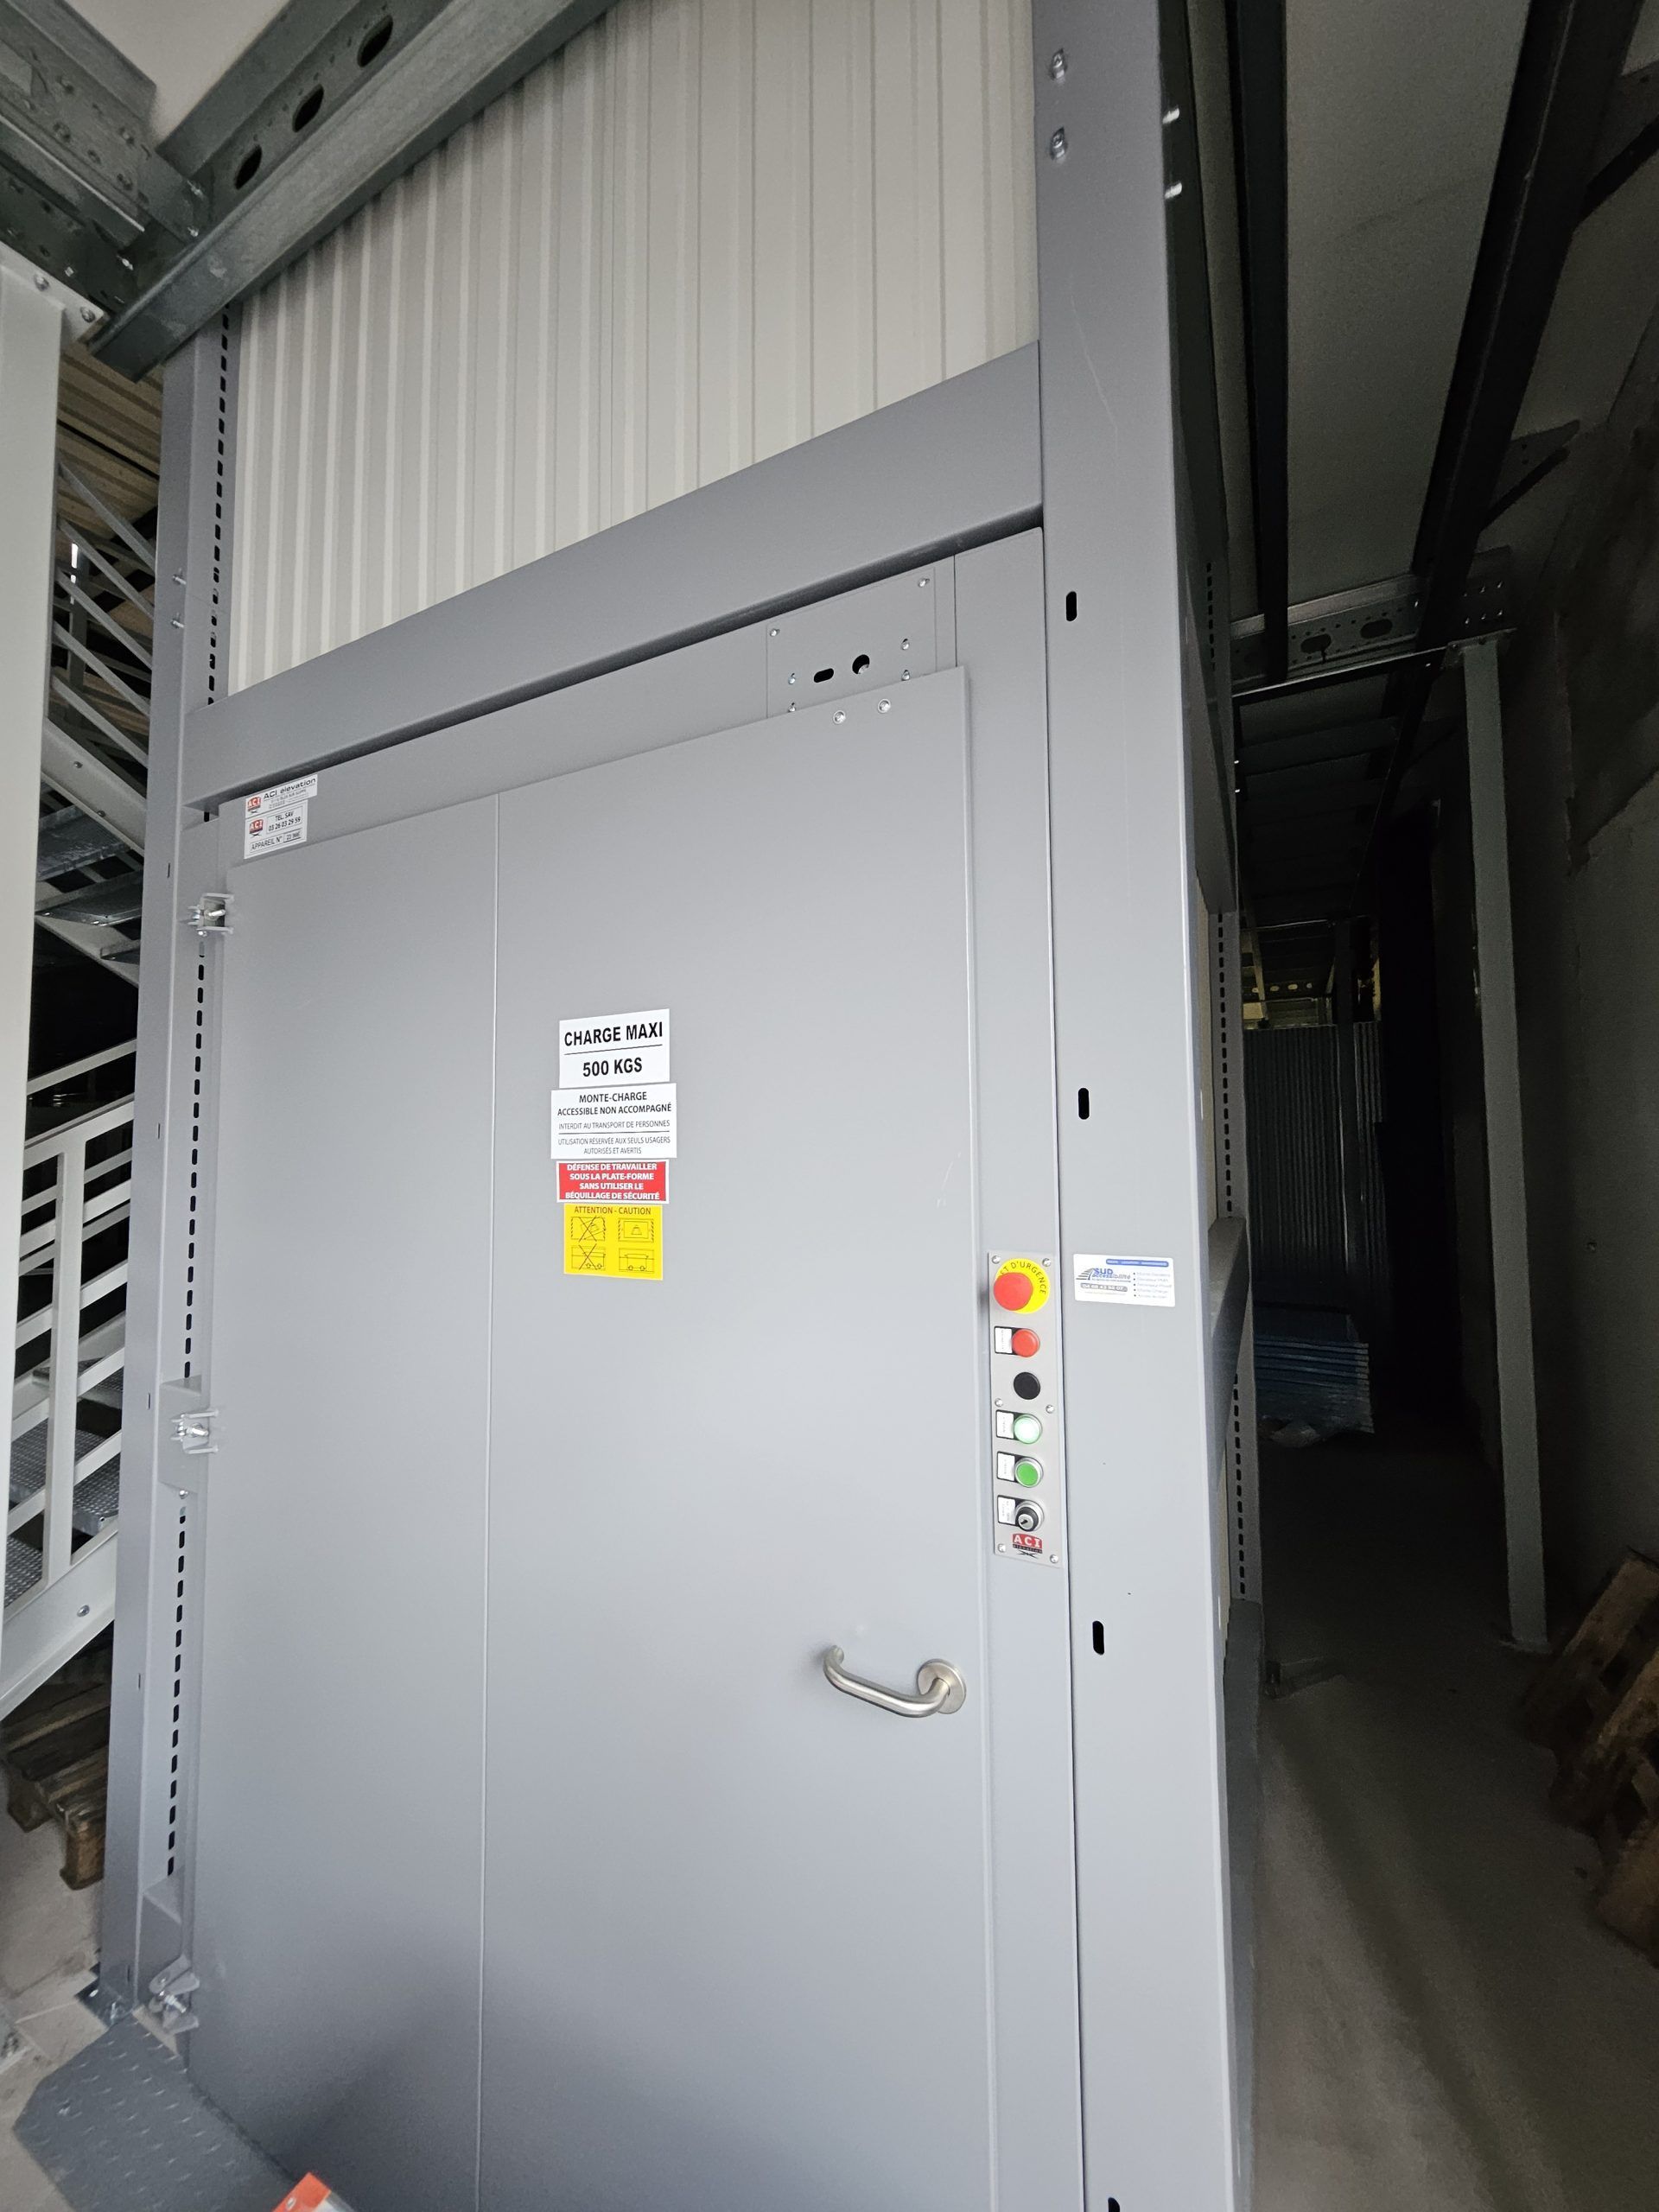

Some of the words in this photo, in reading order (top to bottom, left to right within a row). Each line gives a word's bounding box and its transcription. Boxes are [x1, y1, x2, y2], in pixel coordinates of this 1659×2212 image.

[264, 791, 277, 799] ACI
[248, 798, 261, 808] ACI
[250, 821, 263, 830] ACI
[251, 839, 275, 850] APPAREIL
[564, 1027, 621, 1046] CHARGE
[626, 1021, 663, 1040] MAXI
[582, 1060, 609, 1077] 500
[614, 1057, 642, 1074] KGS
[579, 1091, 647, 1103] MONTE-CHARGE
[557, 1107, 599, 1116] ACCESSIBLE
[600, 1106, 617, 1115] NON
[618, 1102, 672, 1114] ACCOMPAGNÉ
[588, 1136, 614, 1145] RÉSERVÉE
[624, 1192, 660, 1200] SÉCURITÉ
[1010, 1261, 1046, 1294] D'URGENCE
[1014, 1534, 1040, 1548] ACI
